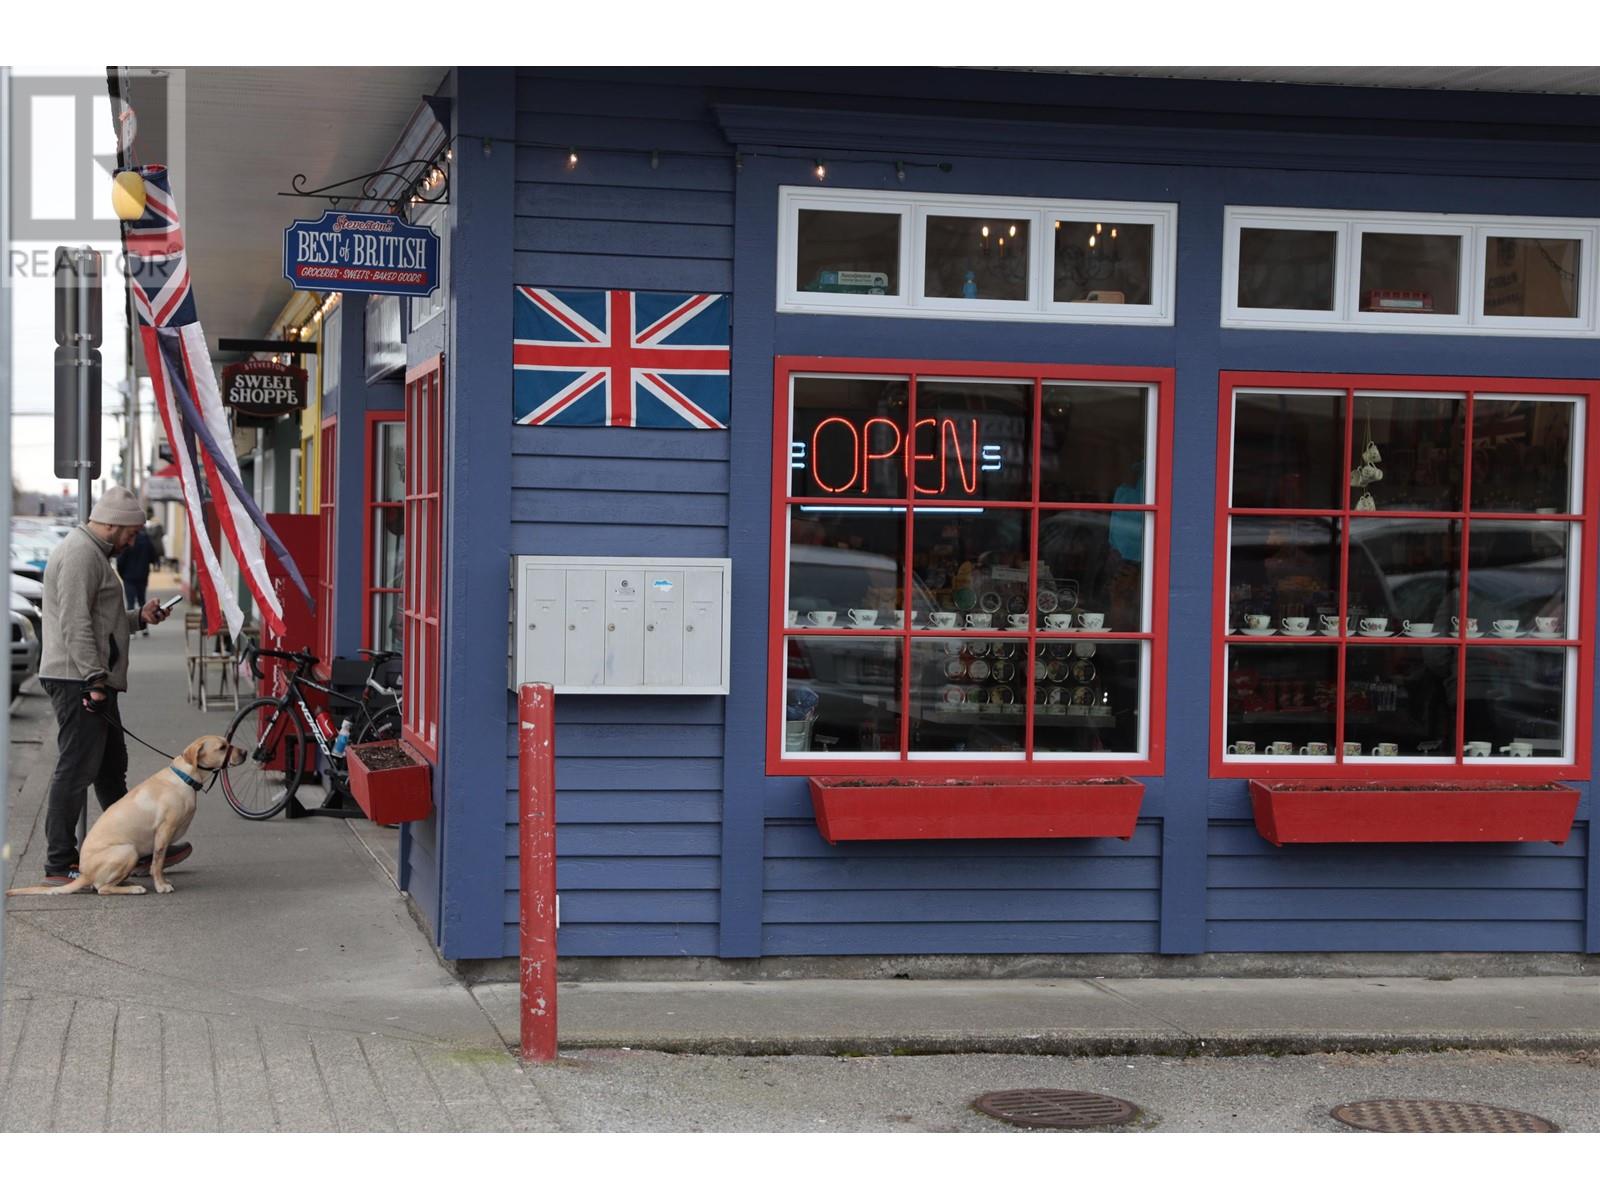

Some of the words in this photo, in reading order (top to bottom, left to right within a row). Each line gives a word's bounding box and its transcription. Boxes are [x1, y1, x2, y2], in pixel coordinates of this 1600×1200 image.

[332, 214, 395, 233] Steveston's
[297, 230, 341, 264] BEST
[339, 238, 350, 262] of
[352, 233, 427, 269] BRITISH
[301, 266, 340, 278] GROCERIES
[342, 268, 371, 280] SWEETS
[372, 271, 398, 281] BAKED
[398, 272, 422, 283] GOODS
[235, 374, 294, 389] SWEET
[229, 387, 299, 405] SHOPPE
[812, 416, 978, 494] OPEN
[298, 701, 331, 756] NORCO
